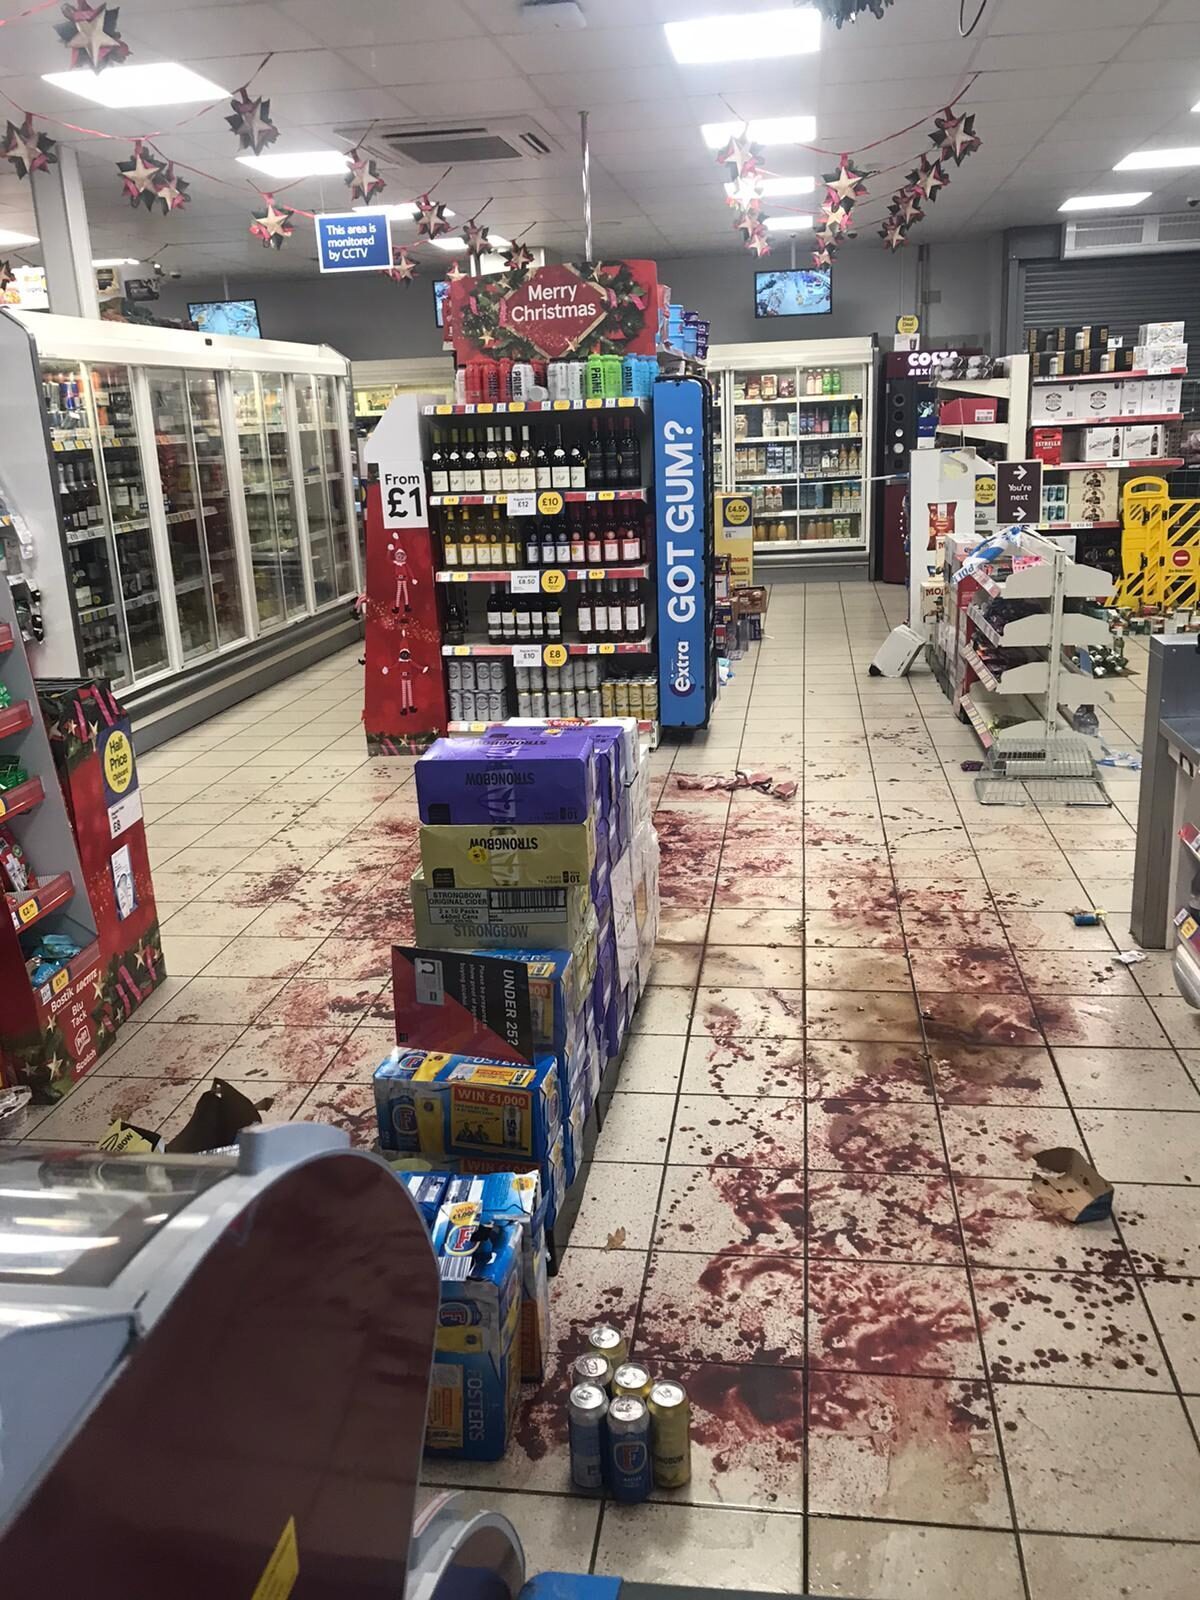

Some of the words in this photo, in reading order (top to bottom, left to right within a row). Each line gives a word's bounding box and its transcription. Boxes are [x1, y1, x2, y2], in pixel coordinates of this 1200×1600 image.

[326, 224, 345, 236] This
[347, 225, 367, 235] area
[368, 223, 377, 234] is
[328, 235, 375, 248] monitored
[329, 249, 341, 262] by
[342, 248, 368, 260] CCTV
[528, 284, 578, 302] Merry
[511, 303, 598, 323] Christmas
[513, 370, 522, 397] PRIME
[591, 367, 602, 394] PRIME
[385, 473, 420, 485] From
[663, 420, 696, 534] GUM?
[1008, 483, 1032, 492] You're
[387, 487, 422, 518] £1
[542, 497, 559, 507] £10
[728, 504, 748, 513] £4.50
[548, 575, 559, 585] £7
[666, 541, 696, 624] GOT
[549, 650, 561, 659] £8
[674, 641, 691, 692] extra
[109, 735, 123, 755] Half
[109, 753, 128, 772] Price
[465, 773, 536, 788] STRONGBOW
[469, 837, 538, 851] STRONGBOW
[570, 875, 581, 884] 10
[453, 924, 528, 939] STRONGBOW
[50, 988, 75, 1014] Bostik
[503, 969, 518, 1018] UNDER
[71, 1001, 84, 1017] Blu
[70, 1010, 88, 1029] Tack
[505, 1020, 520, 1047] 25?
[75, 1048, 97, 1074] Scotch
[457, 1088, 486, 1104] WIN
[488, 1094, 527, 1109] £1,000
